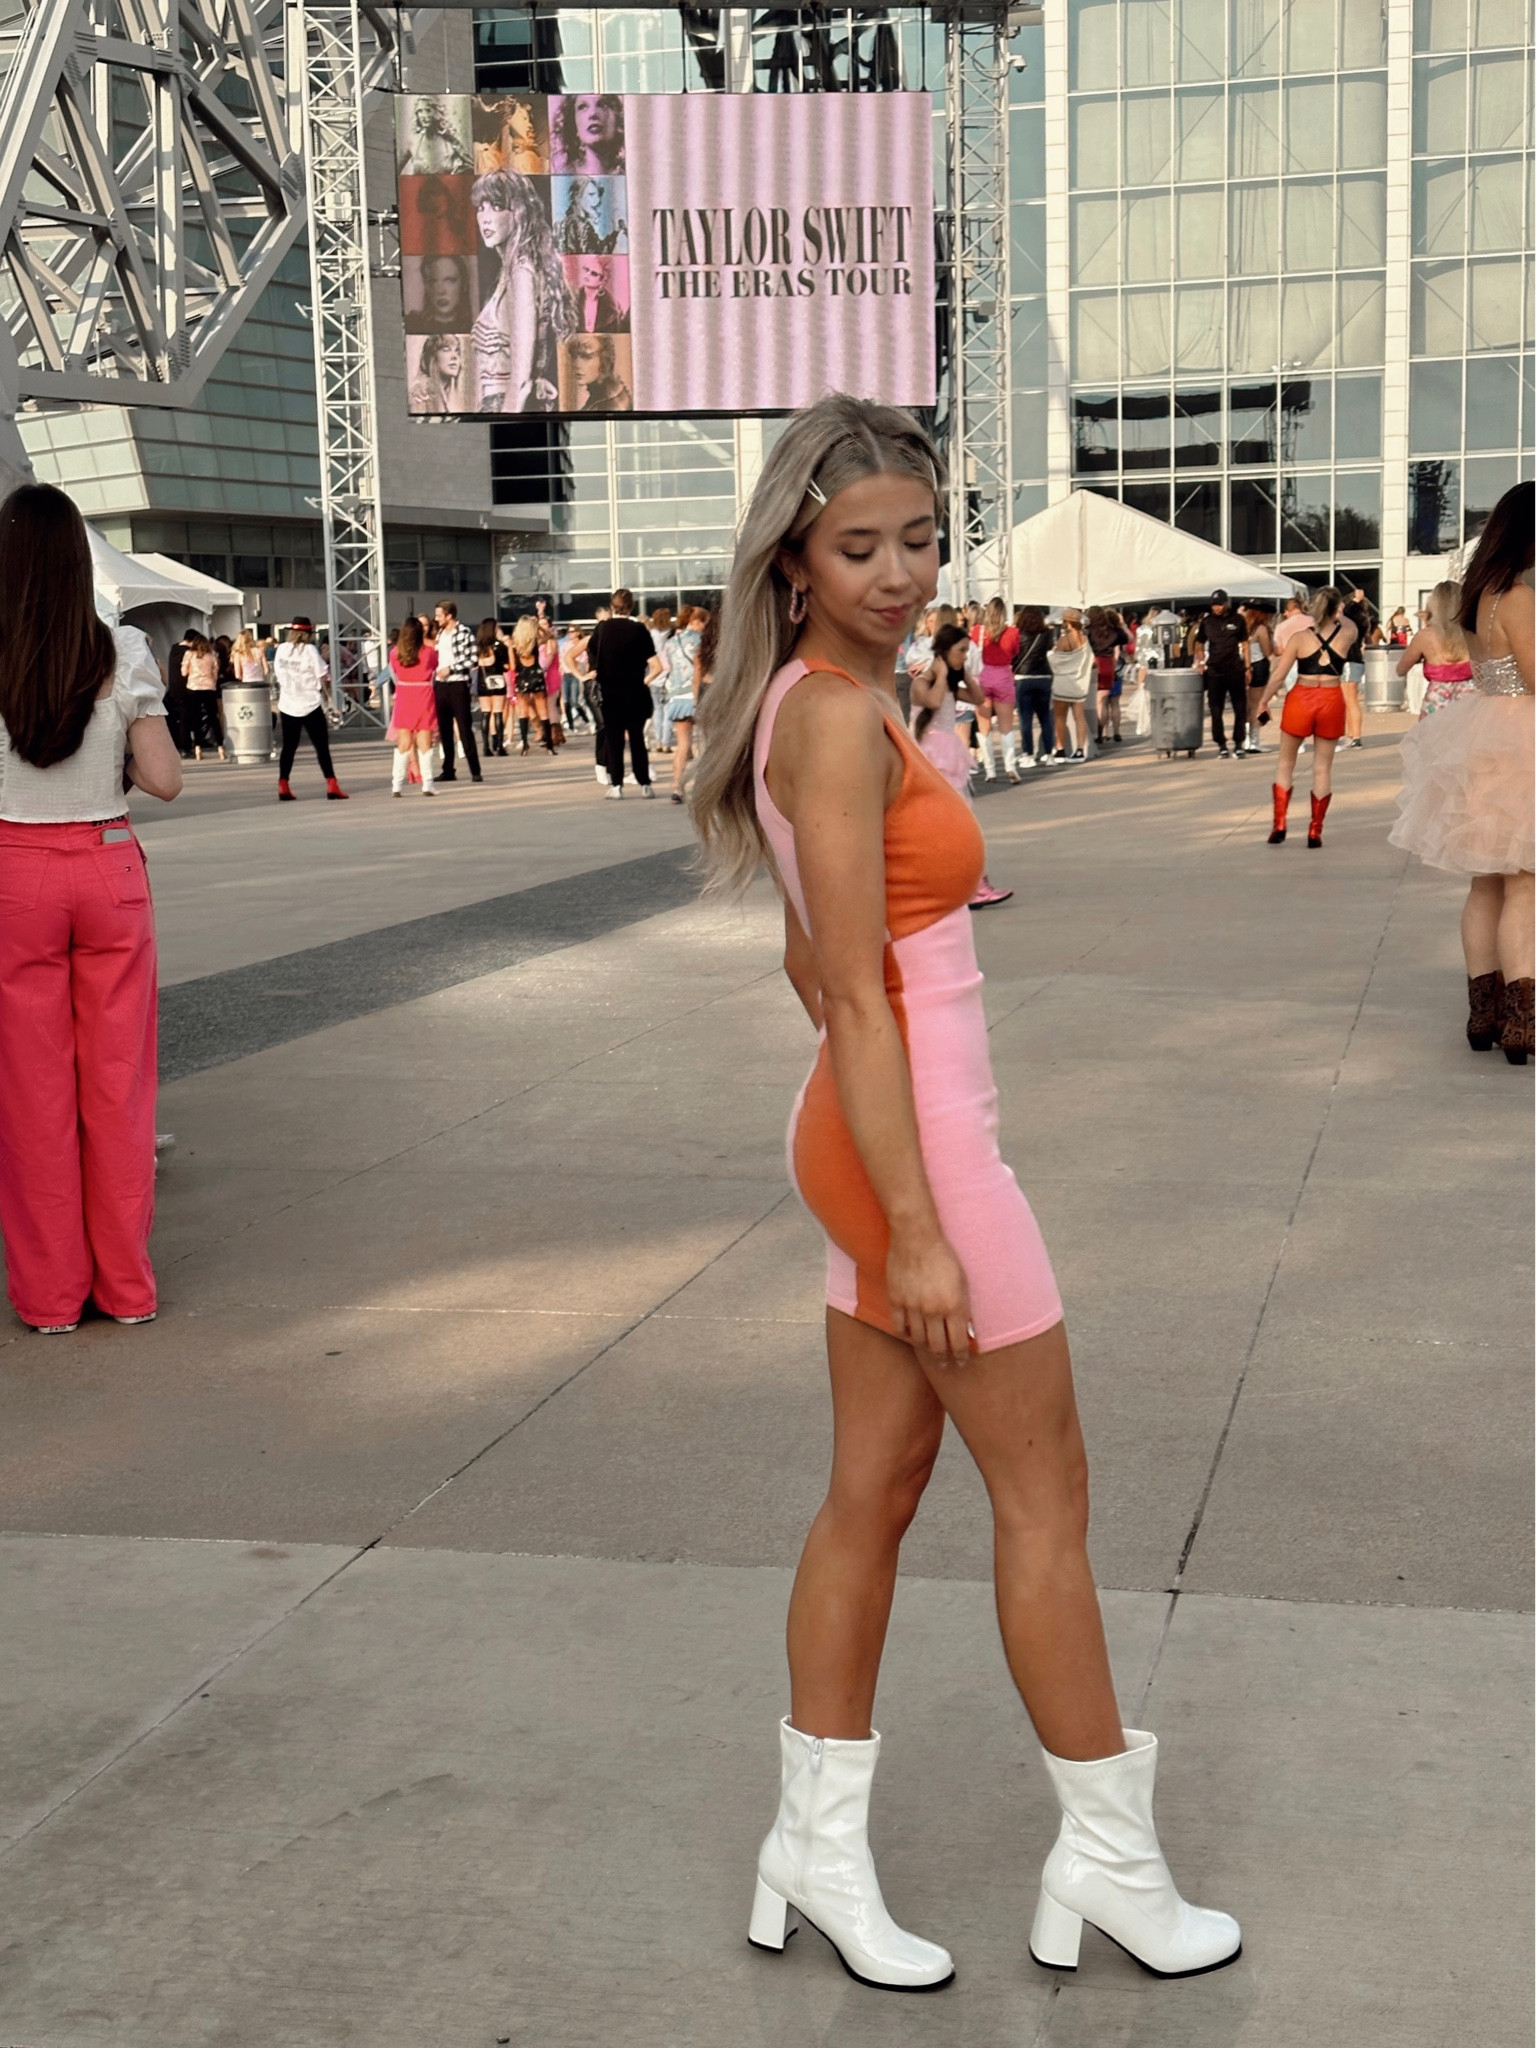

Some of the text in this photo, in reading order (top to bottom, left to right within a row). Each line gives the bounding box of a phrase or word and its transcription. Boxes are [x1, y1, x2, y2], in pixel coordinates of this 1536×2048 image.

[653, 206, 912, 266] TAYLOR SWIFT
[655, 267, 912, 298] THE ERAS TOUR
